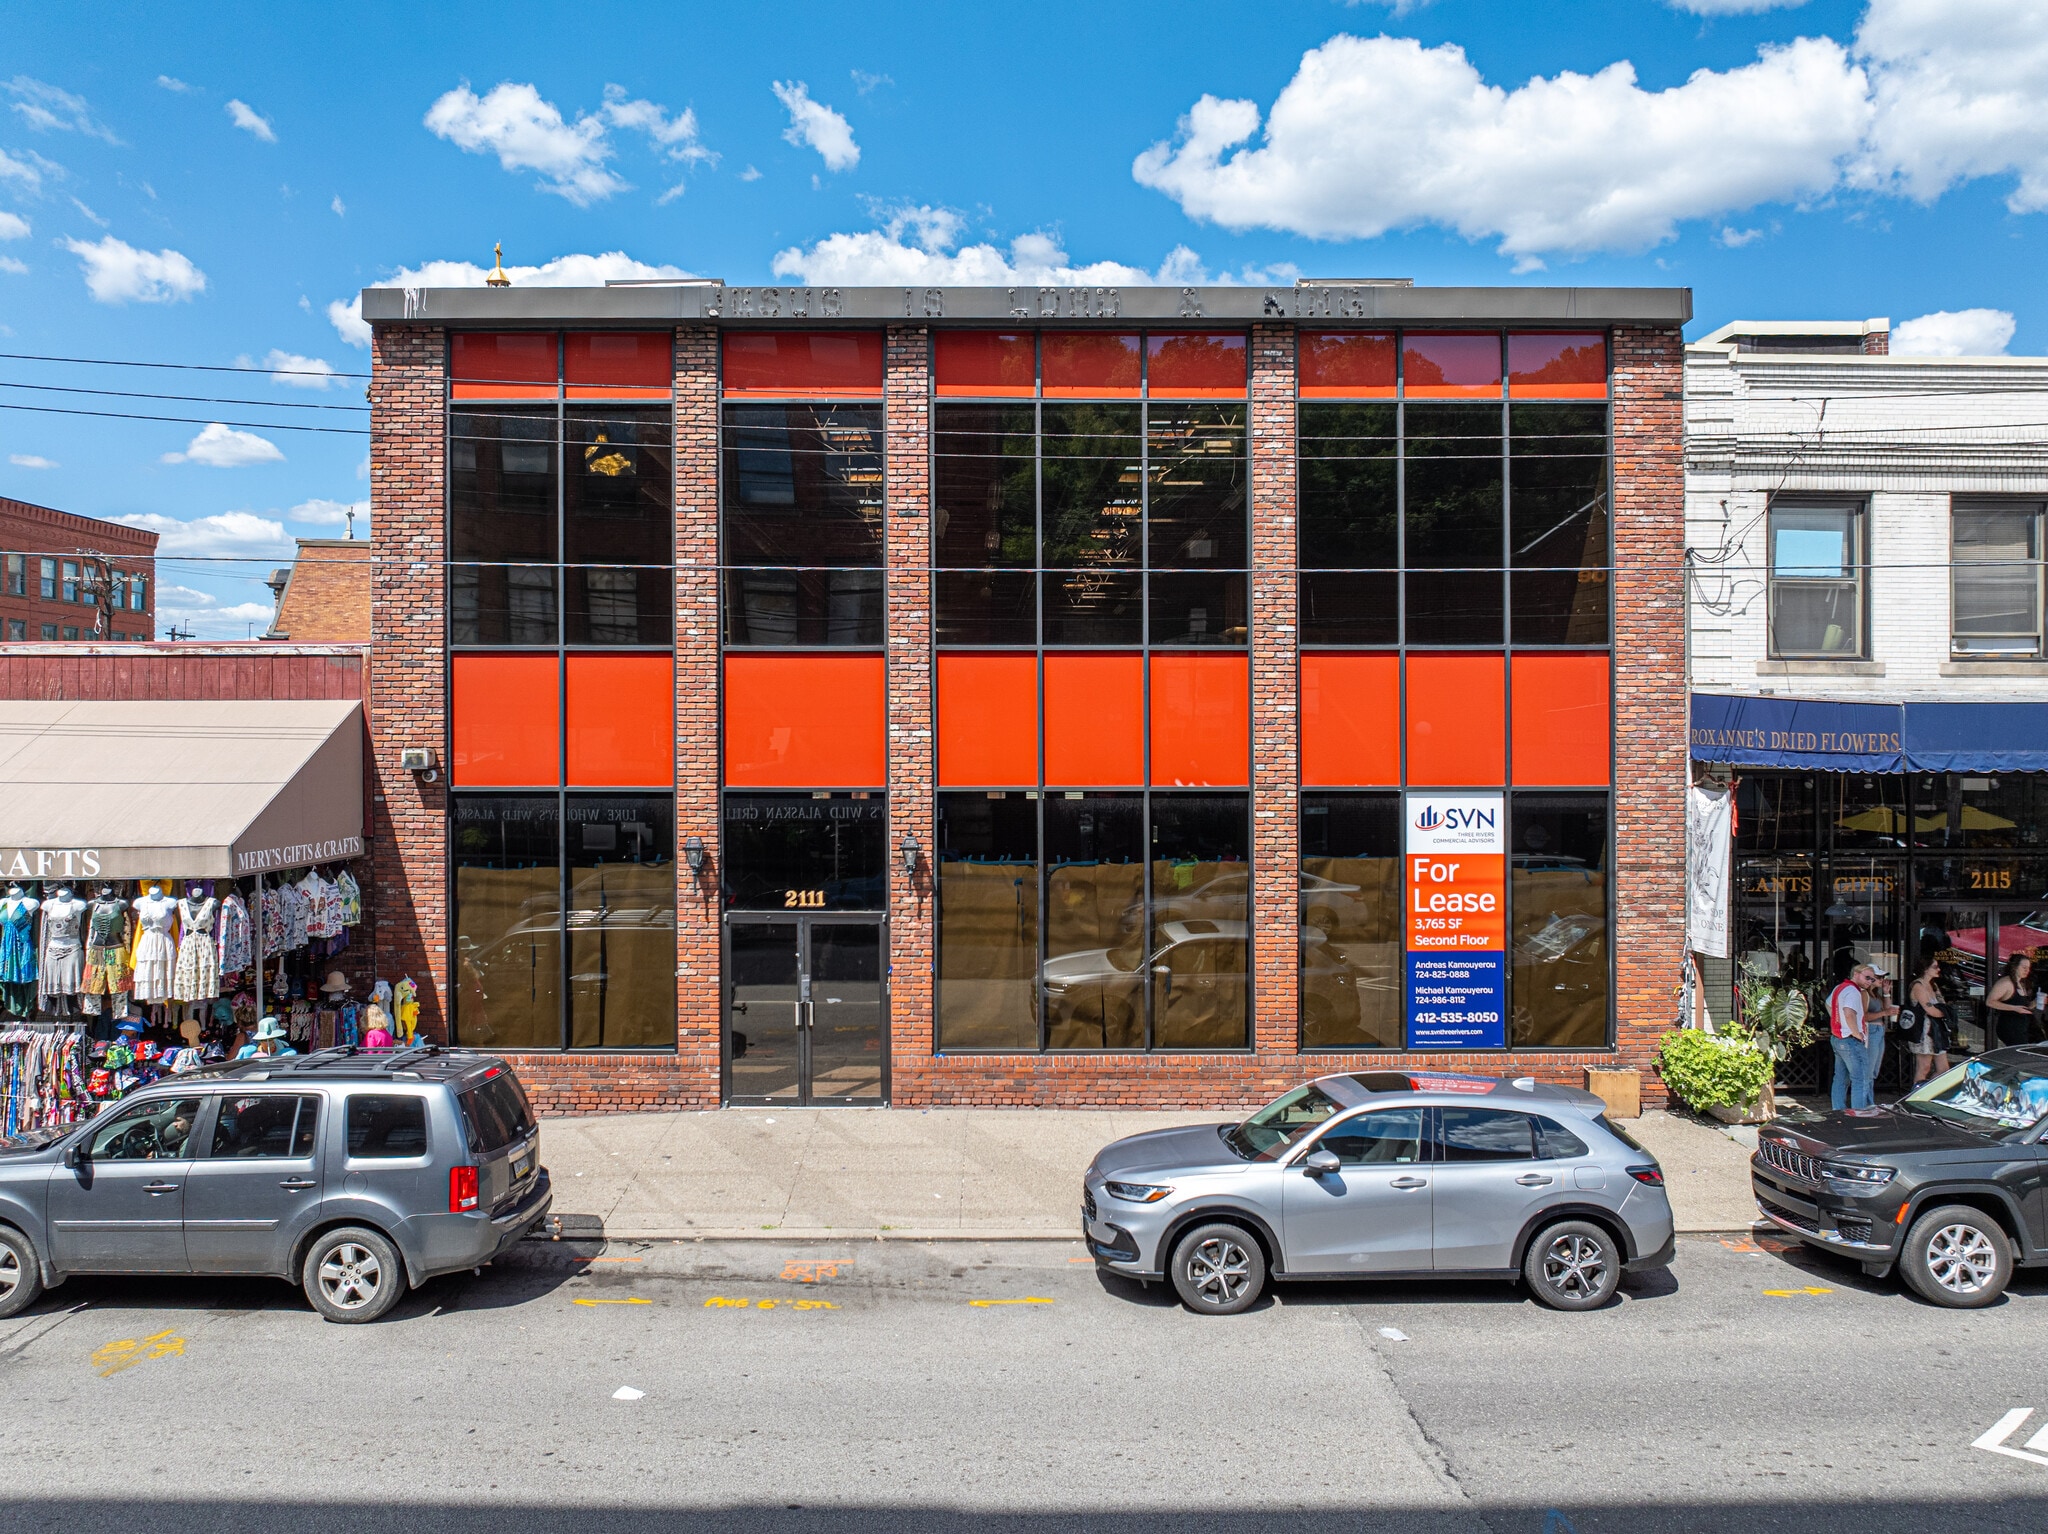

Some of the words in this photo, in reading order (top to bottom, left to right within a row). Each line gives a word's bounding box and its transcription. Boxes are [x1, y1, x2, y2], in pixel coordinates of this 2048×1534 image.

[1691, 728, 1766, 749] ROXANNE'S
[1771, 732, 1816, 751] DRIED
[1821, 733, 1901, 753] FLOWERS
[1445, 808, 1495, 829] SVN
[238, 849, 281, 871] MERY'S
[283, 844, 314, 868] GIFTS
[314, 843, 323, 859] &
[323, 836, 360, 858] CRAFTS
[1414, 858, 1460, 883] For
[1833, 876, 1895, 892] GIFTS
[1971, 871, 2011, 889] 2115
[784, 889, 826, 908] 2111
[1414, 888, 1496, 913] Lease
[1415, 918, 1446, 931] 3,765
[1448, 918, 1463, 929] SF
[1415, 935, 1457, 946] Second
[1460, 935, 1489, 946] Floor
[1415, 961, 1447, 969] Andreas
[1448, 961, 1496, 970] Kamouyerou
[1415, 971, 1470, 979] 724-825-0888
[1415, 986, 1444, 994] Michael
[1445, 986, 1494, 996] Kamouyerou
[1415, 996, 1466, 1004] 724-986-8112
[1415, 1012, 1499, 1023] 412-535-8050
